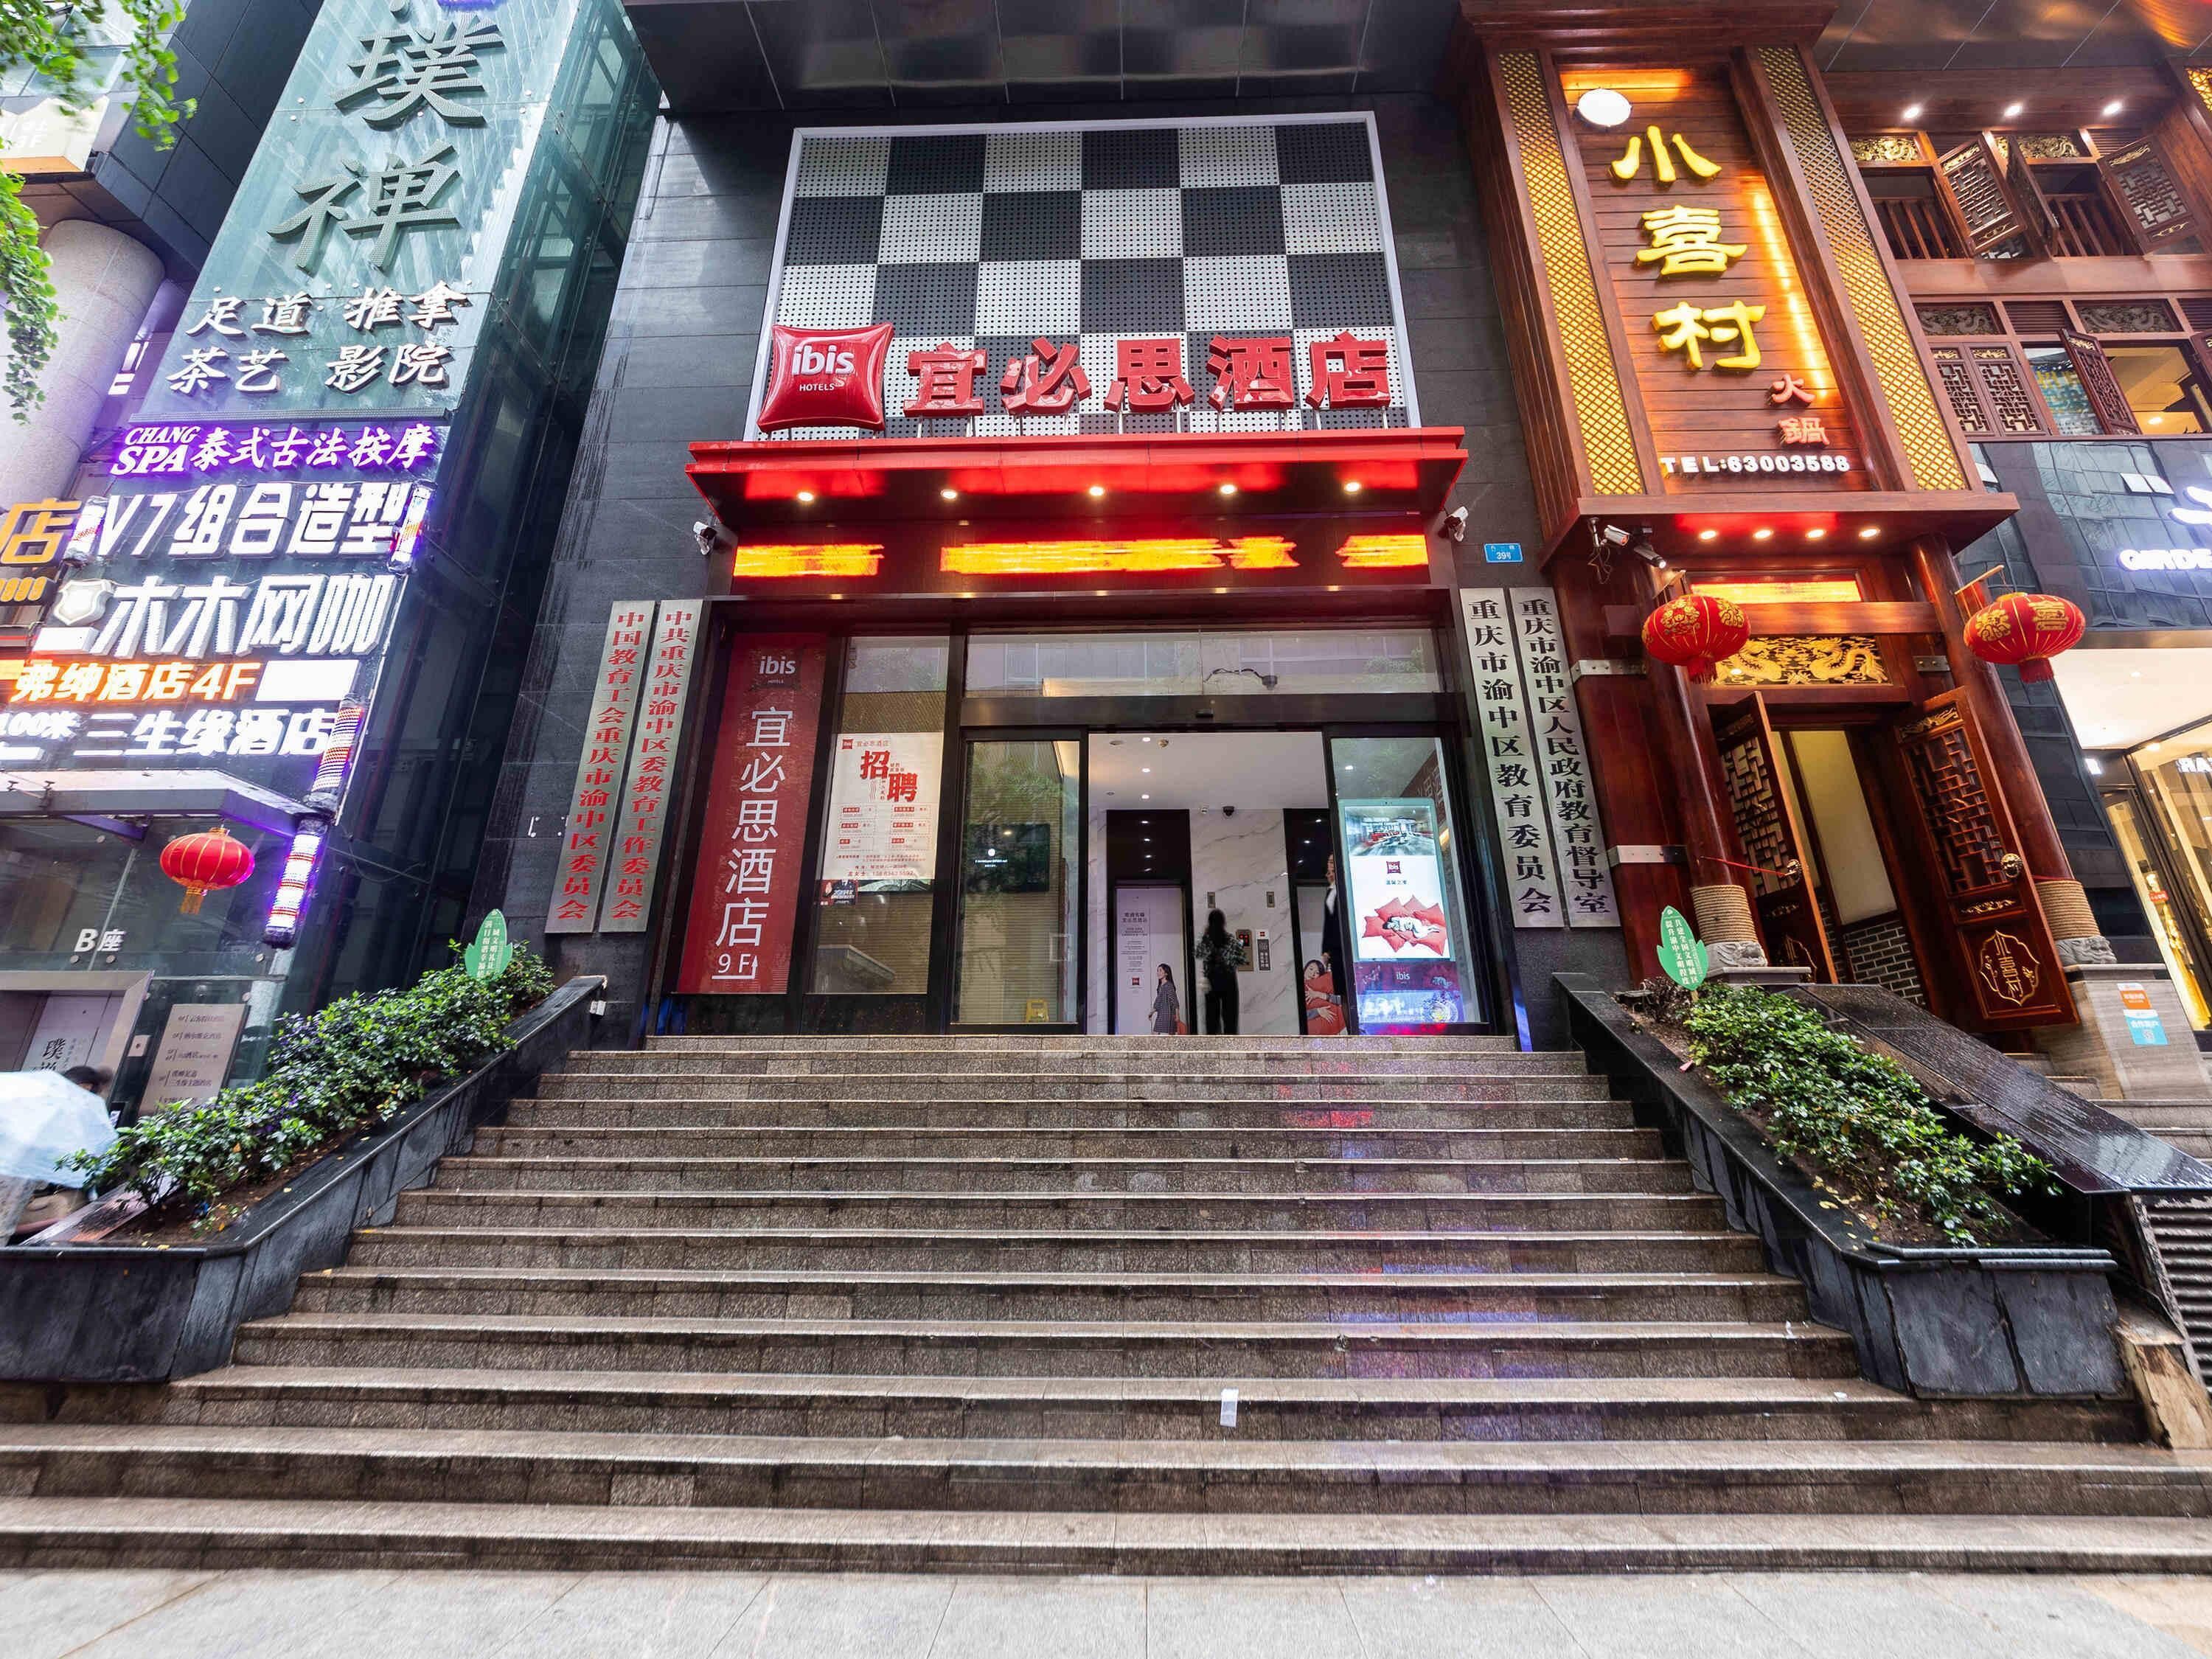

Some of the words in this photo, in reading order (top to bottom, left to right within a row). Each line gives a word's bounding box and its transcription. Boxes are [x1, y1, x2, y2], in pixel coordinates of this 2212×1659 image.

[1609, 125, 1767, 370] 小喜村
[186, 290, 314, 337] 足道
[343, 280, 473, 330] 推拿
[167, 347, 289, 394] 茶艺
[324, 342, 454, 396] 影院
[791, 344, 855, 375] ibis
[902, 330, 1393, 418] 宜必思酒店
[799, 383, 835, 392] HOTELS
[110, 445, 189, 476] SPA
[124, 425, 201, 445] CHANG
[190, 423, 437, 473] 泰式古法按摩
[1659, 454, 1851, 473] TEL:63003588
[0, 498, 82, 566] 店
[98, 482, 413, 558] V7组合造型
[91, 575, 397, 658] 木木网咖
[10, 661, 261, 703] 弗绅酒店4F
[759, 655, 796, 675] ibis
[72, 709, 336, 757] 三生缘酒店
[1468, 598, 1552, 914] 重庆市渝中区教育委员会
[1517, 598, 1612, 914] 重庆市渝中区人民政府教育督导室
[556, 611, 646, 920] 中国教育工会重庆市渝中区委员会
[611, 611, 693, 920] 中共重庆市渝中区委教育工作委员会
[860, 750, 918, 803] 招聘
[715, 706, 793, 947] 宜必思酒店
[74, 928, 128, 953] B座
[1396, 971, 1411, 981] ibis
